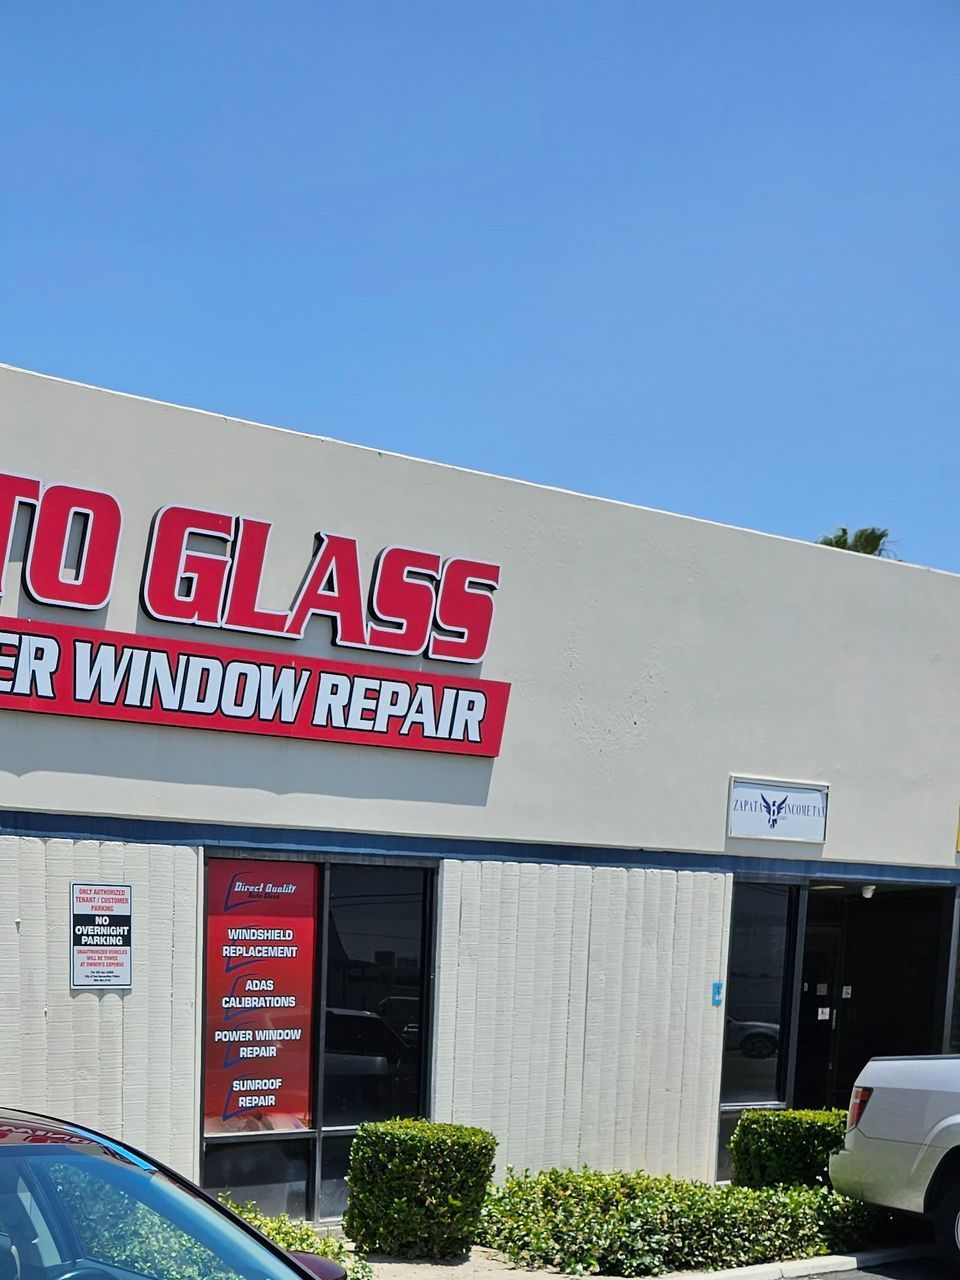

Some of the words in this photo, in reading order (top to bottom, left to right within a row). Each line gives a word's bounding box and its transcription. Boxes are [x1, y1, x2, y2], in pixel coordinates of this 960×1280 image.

[143, 503, 502, 664] GLASS
[72, 640, 311, 725] WINDOW
[314, 671, 487, 744] REPAIR
[733, 799, 763, 813] ZAPATA
[784, 803, 810, 817] INCOME
[234, 881, 264, 892] Direct
[265, 883, 296, 893] Quality
[95, 916, 109, 925] NO
[75, 926, 129, 935] OVERNIGHT
[227, 928, 293, 941] WINDSHIELD
[81, 936, 123, 945] PARKING
[222, 946, 298, 958] REPLACEMENT
[245, 980, 274, 991] ADAS
[222, 996, 296, 1008] CALIBRATIONS
[215, 1030, 253, 1042] POWER
[255, 1029, 301, 1041] WINDOW
[239, 1047, 277, 1058] REPAIR
[232, 1079, 282, 1091] SUNROOF
[238, 1095, 276, 1108] REPAIR
